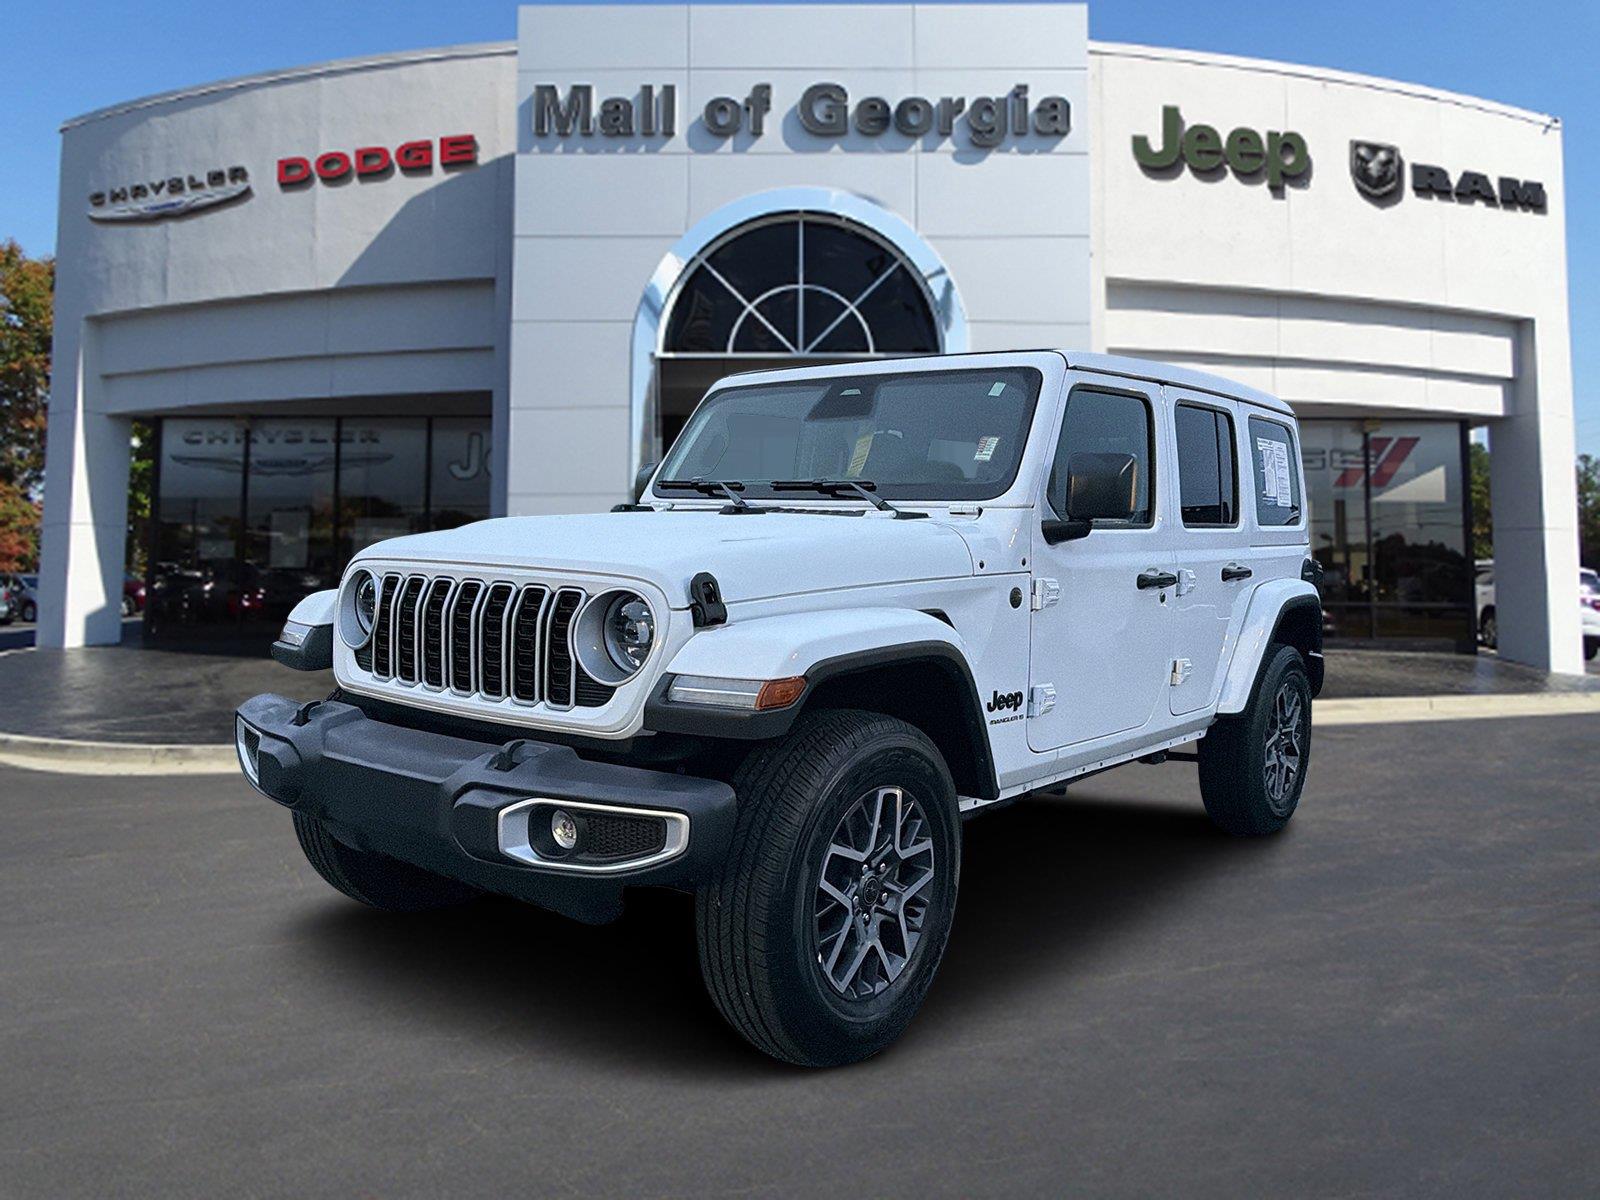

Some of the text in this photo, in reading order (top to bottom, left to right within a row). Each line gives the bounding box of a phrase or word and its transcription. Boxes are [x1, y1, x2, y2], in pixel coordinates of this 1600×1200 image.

[531, 83, 1072, 147] Mall of Georgia
[277, 134, 477, 187] DODGE
[1131, 105, 1309, 190] Jeep
[89, 165, 249, 207] CHRYSLER
[1411, 163, 1548, 213] RAM
[986, 690, 1024, 713] Jeep
